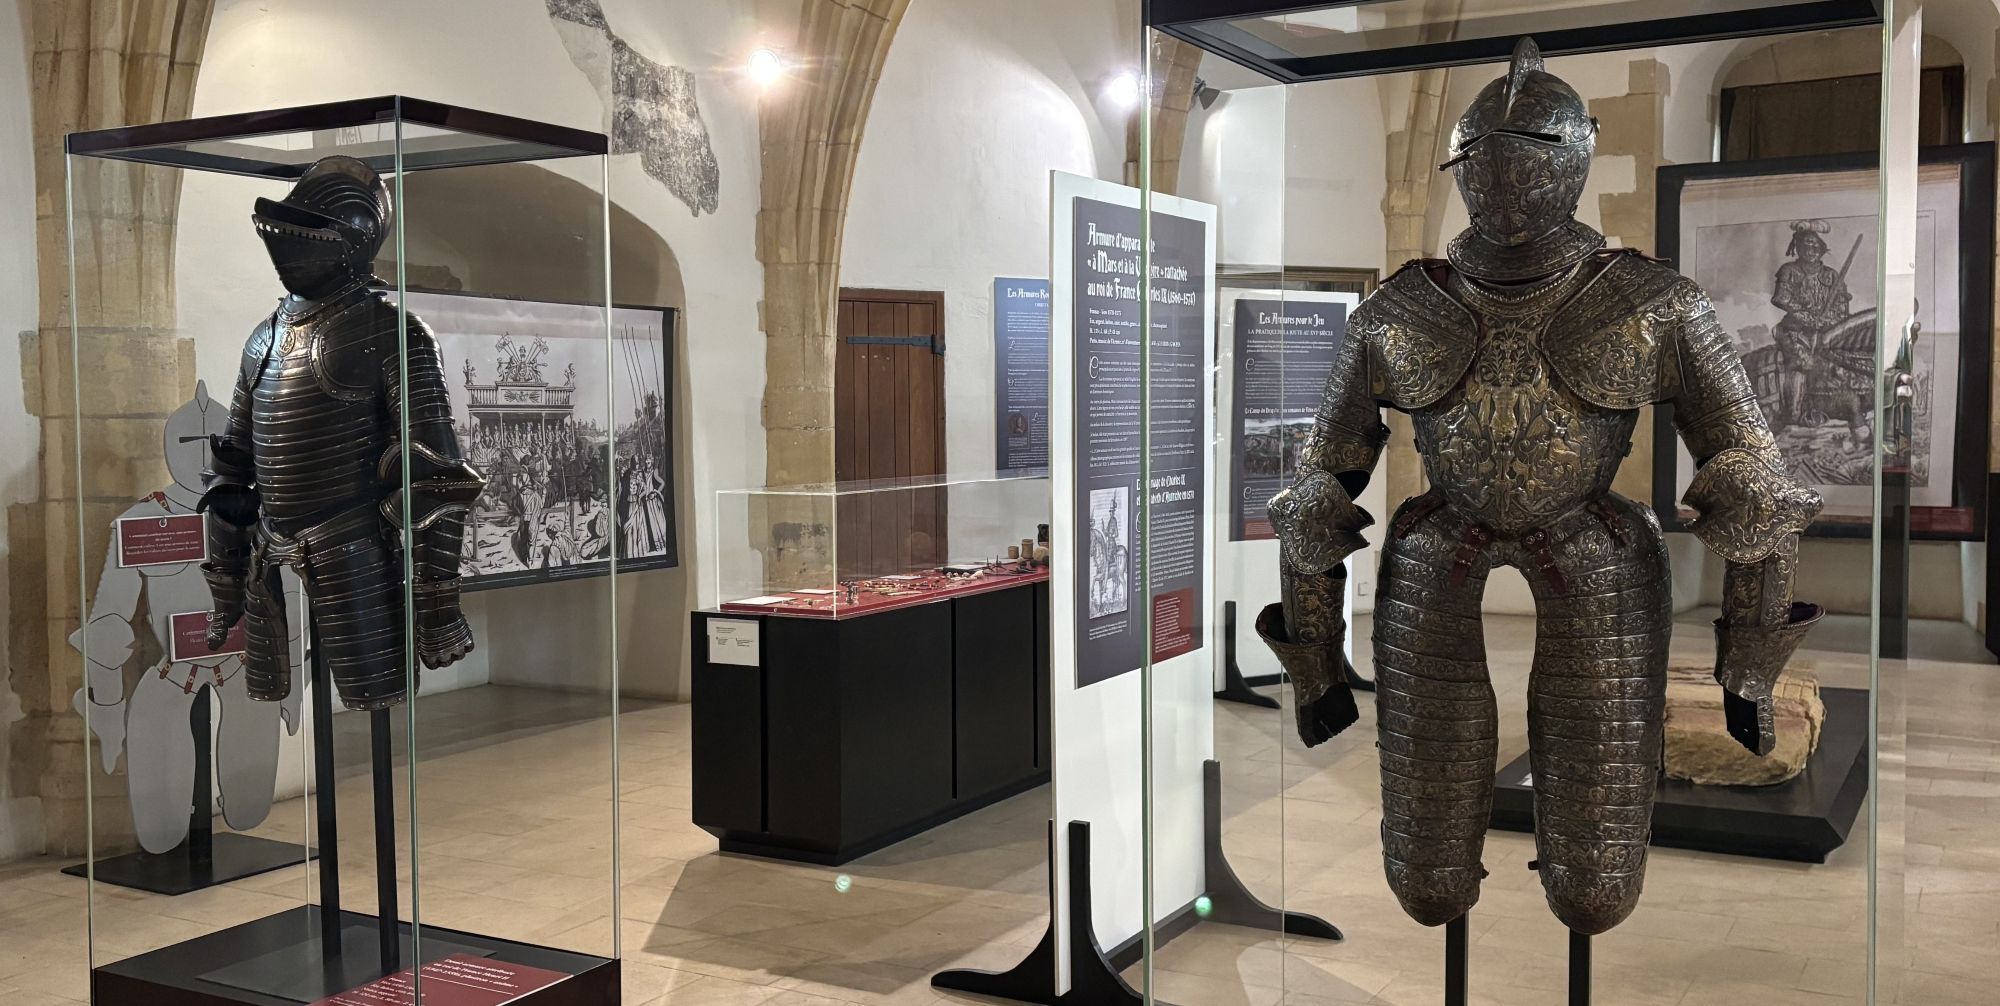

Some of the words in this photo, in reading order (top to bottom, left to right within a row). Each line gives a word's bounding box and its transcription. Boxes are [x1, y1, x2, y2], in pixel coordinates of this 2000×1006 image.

[1088, 222, 1115, 247] Armure
[1116, 233, 1143, 252] d'appara
[1097, 250, 1117, 274] Mars
[1118, 258, 1124, 274] et
[1129, 259, 1134, 275] la
[1165, 265, 1187, 282] rattachée
[1008, 288, 1016, 298] Les
[1017, 288, 1040, 298] Armures
[1088, 282, 1095, 296] au
[1096, 282, 1105, 298] roi
[1106, 282, 1113, 298] de
[1114, 278, 1136, 300] France
[1259, 312, 1270, 324] Les
[1271, 312, 1294, 325] Armures
[1295, 317, 1307, 326] pour
[1308, 316, 1312, 325] le
[1314, 314, 1324, 326] Jeu
